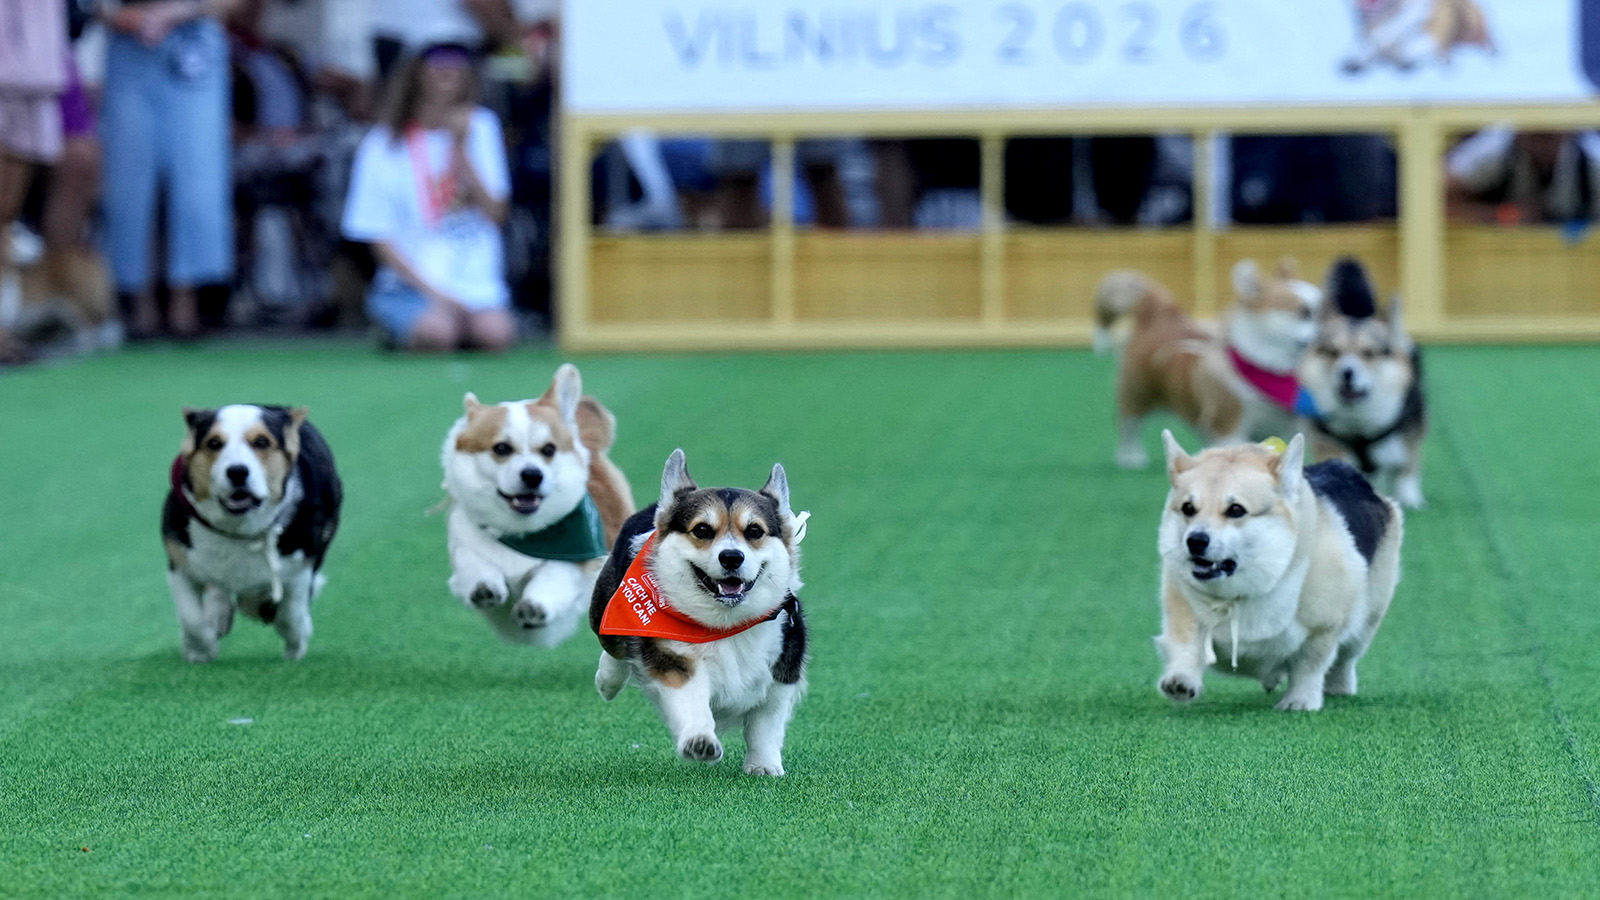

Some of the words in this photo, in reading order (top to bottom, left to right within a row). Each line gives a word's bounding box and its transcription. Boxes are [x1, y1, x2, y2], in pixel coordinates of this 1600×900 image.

[662, 4, 964, 70] VILNIUS
[994, 1, 1230, 66] 2026
[622, 585, 637, 603] YOU
[632, 602, 652, 626] CAN!
[627, 577, 648, 601] CATCH
[643, 599, 657, 616] ME
